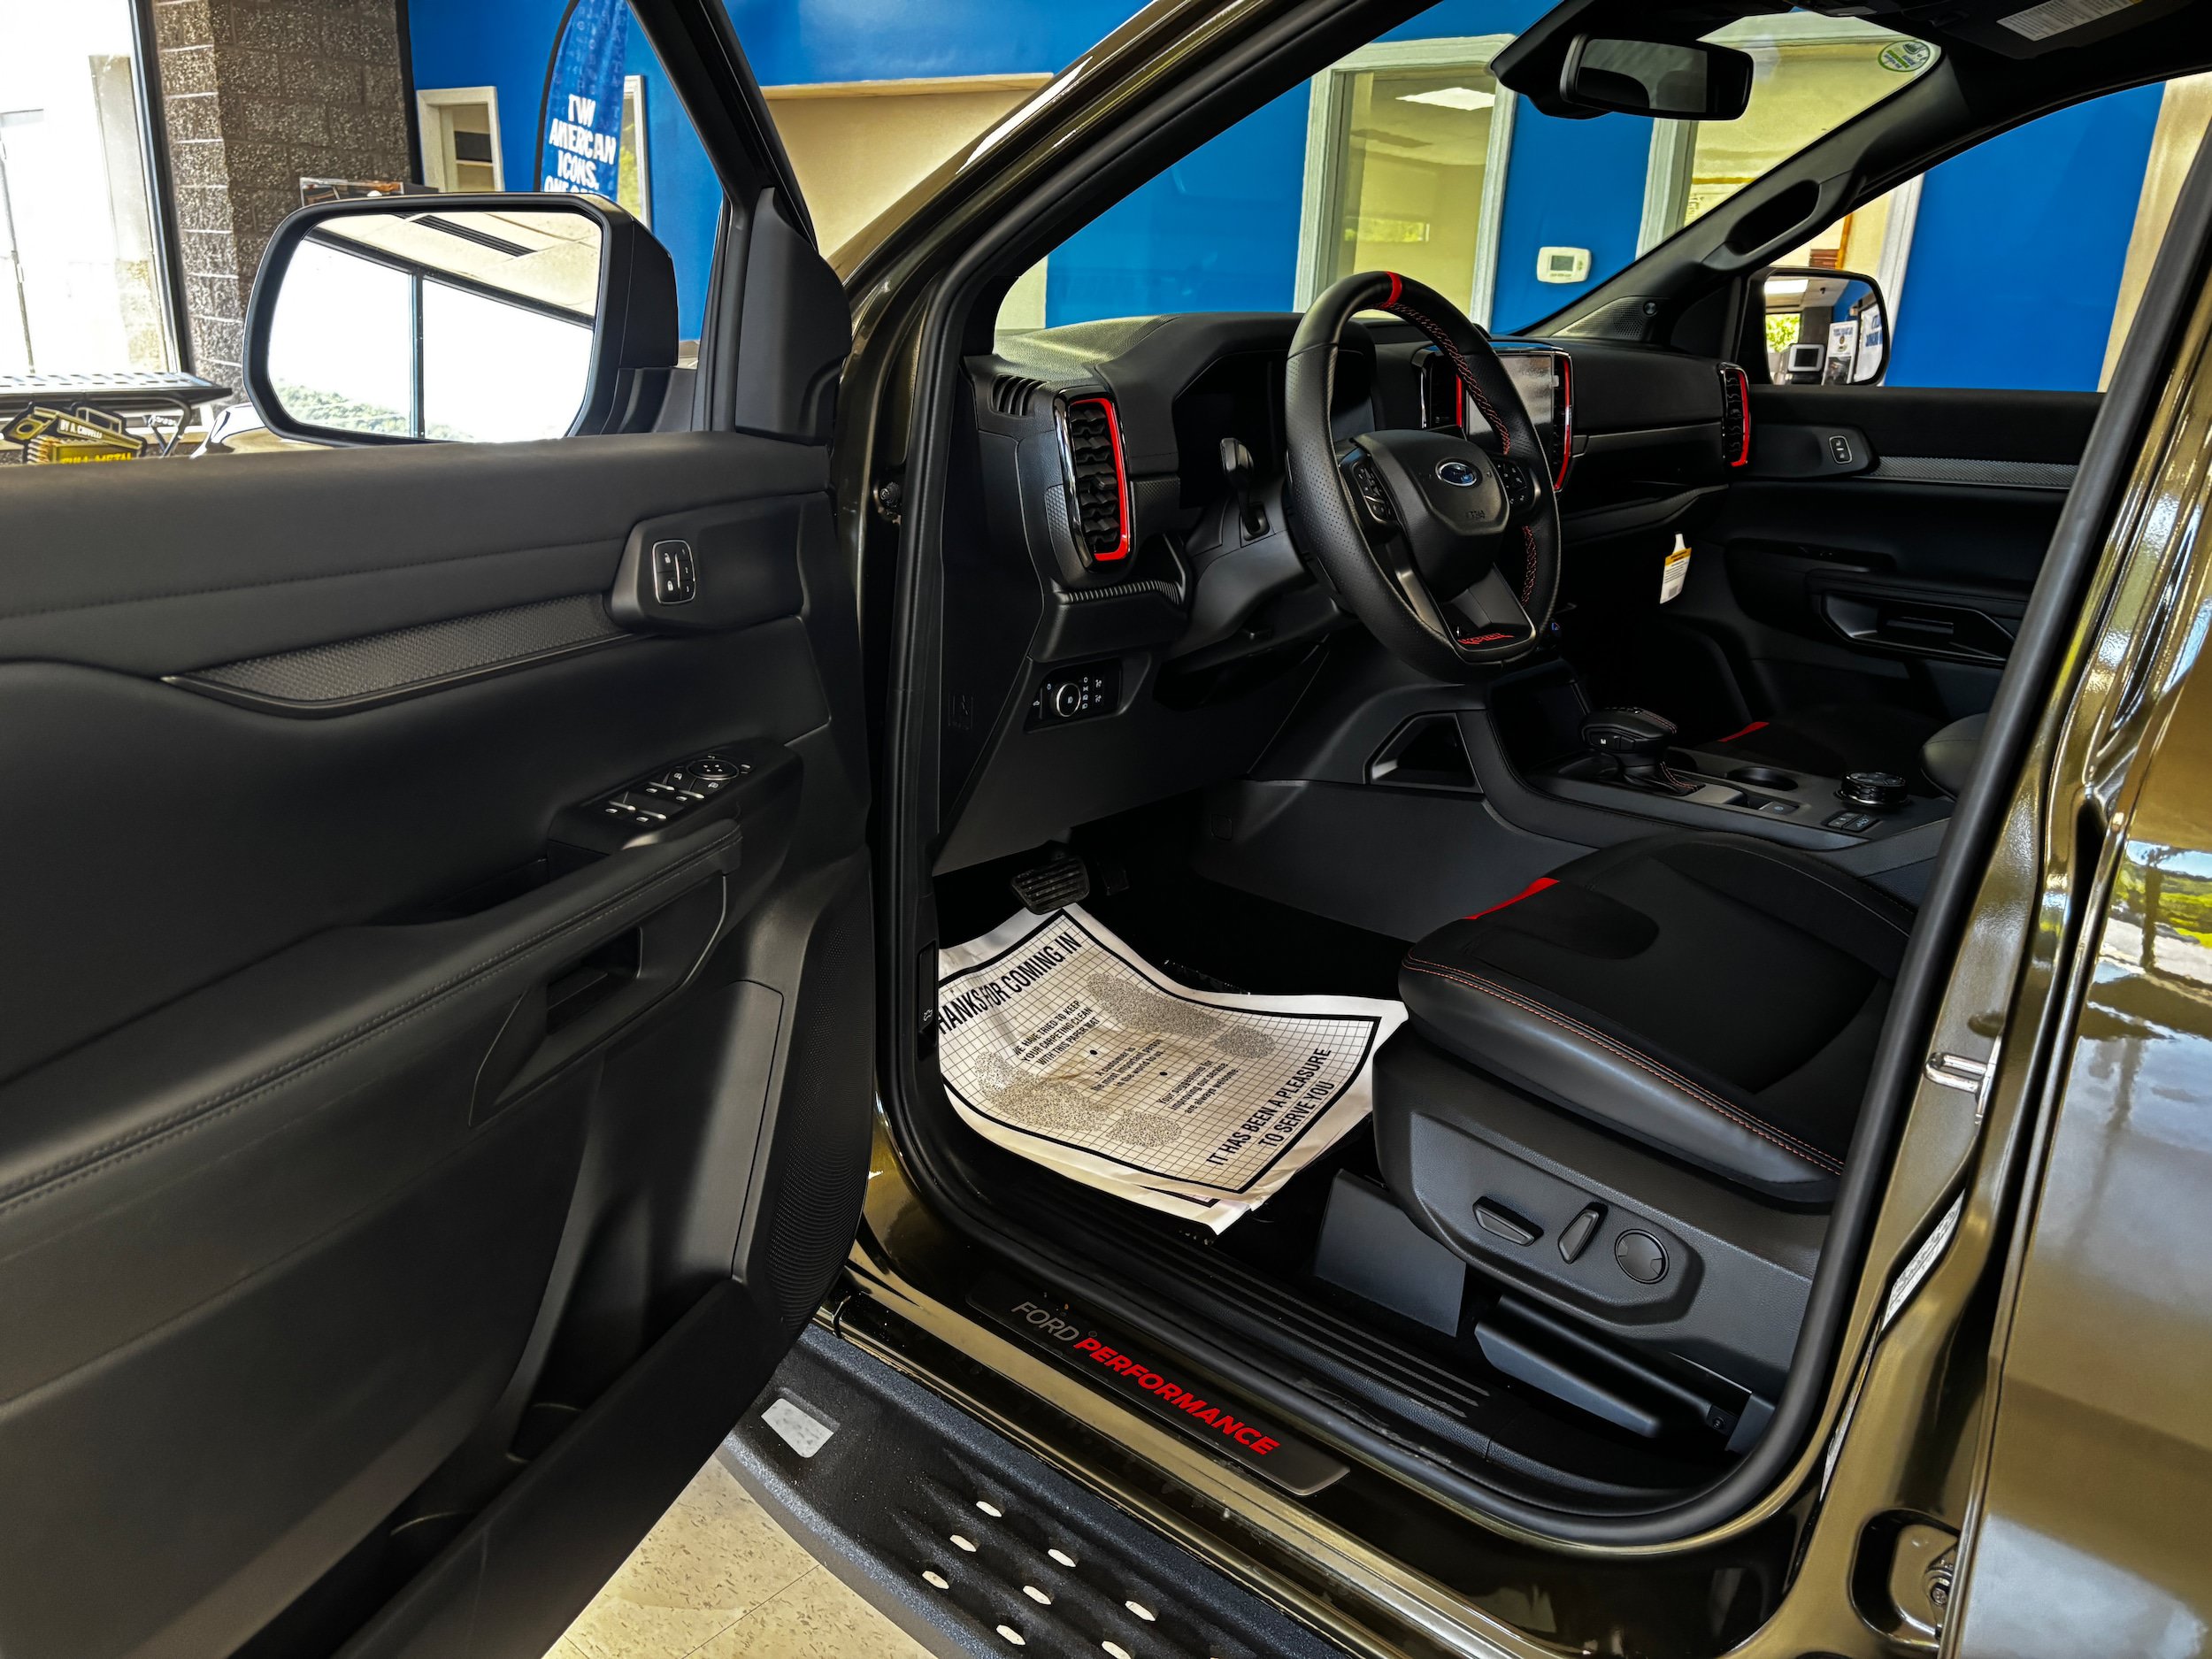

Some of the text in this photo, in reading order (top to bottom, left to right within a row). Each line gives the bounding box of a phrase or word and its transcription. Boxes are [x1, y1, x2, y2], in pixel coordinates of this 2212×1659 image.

[557, 150, 600, 189] ICONS.
[939, 931, 1082, 1035] HANKS FOR COMING IN
[1012, 1000, 1081, 1056] WE HAVE TRIED TO KEEP
[1021, 1007, 1093, 1063] YOUR CARPETING CLEAN
[1036, 1018, 1101, 1066] WITH THIS PAPER MAT
[1156, 1093, 1175, 1104] Your
[1171, 1065, 1206, 1094] suggestions
[1185, 1104, 1198, 1114] are
[1194, 1087, 1217, 1105] always
[1197, 1078, 1209, 1087] our
[1207, 1063, 1228, 1079] service
[1206, 1048, 1332, 1165] IT HAS BEEN A PLEASURE
[1258, 1080, 1335, 1147] TO SERVE YOU
[1010, 1301, 1280, 1455] FORD PERFORMANCE
